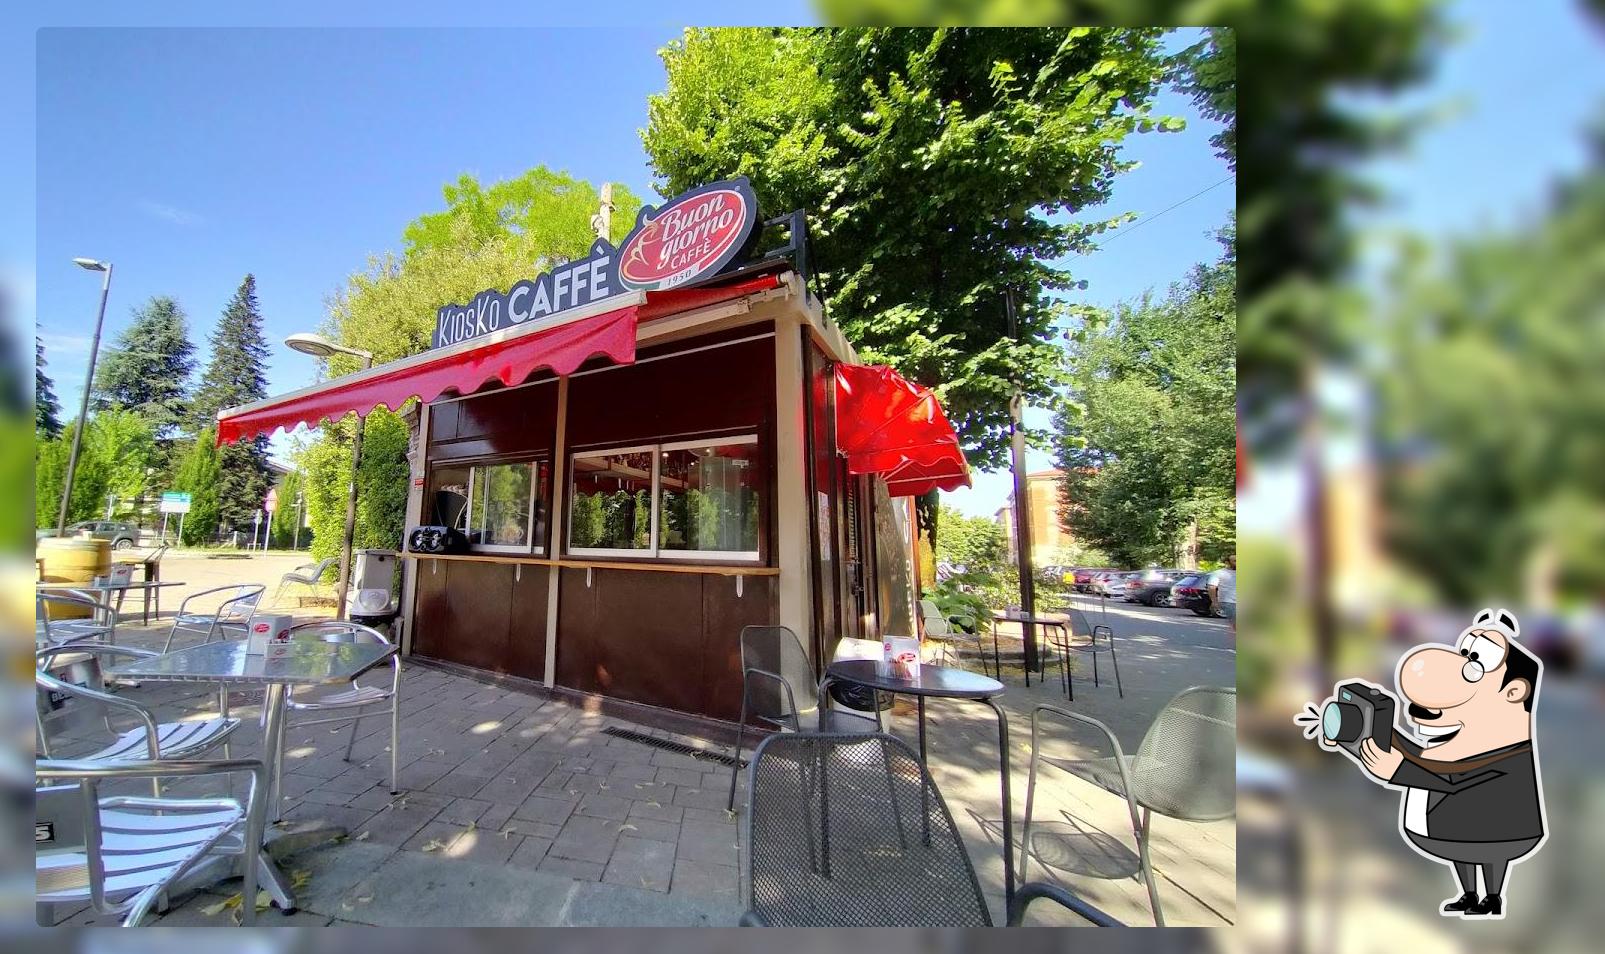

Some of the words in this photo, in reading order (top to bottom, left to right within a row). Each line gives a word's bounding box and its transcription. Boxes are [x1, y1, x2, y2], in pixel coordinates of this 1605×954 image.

[656, 208, 734, 270] giorno
[661, 193, 726, 242] Buon
[667, 269, 692, 286] 1950
[670, 237, 712, 270] CAFFÈ
[507, 245, 610, 323] CAFFÈ
